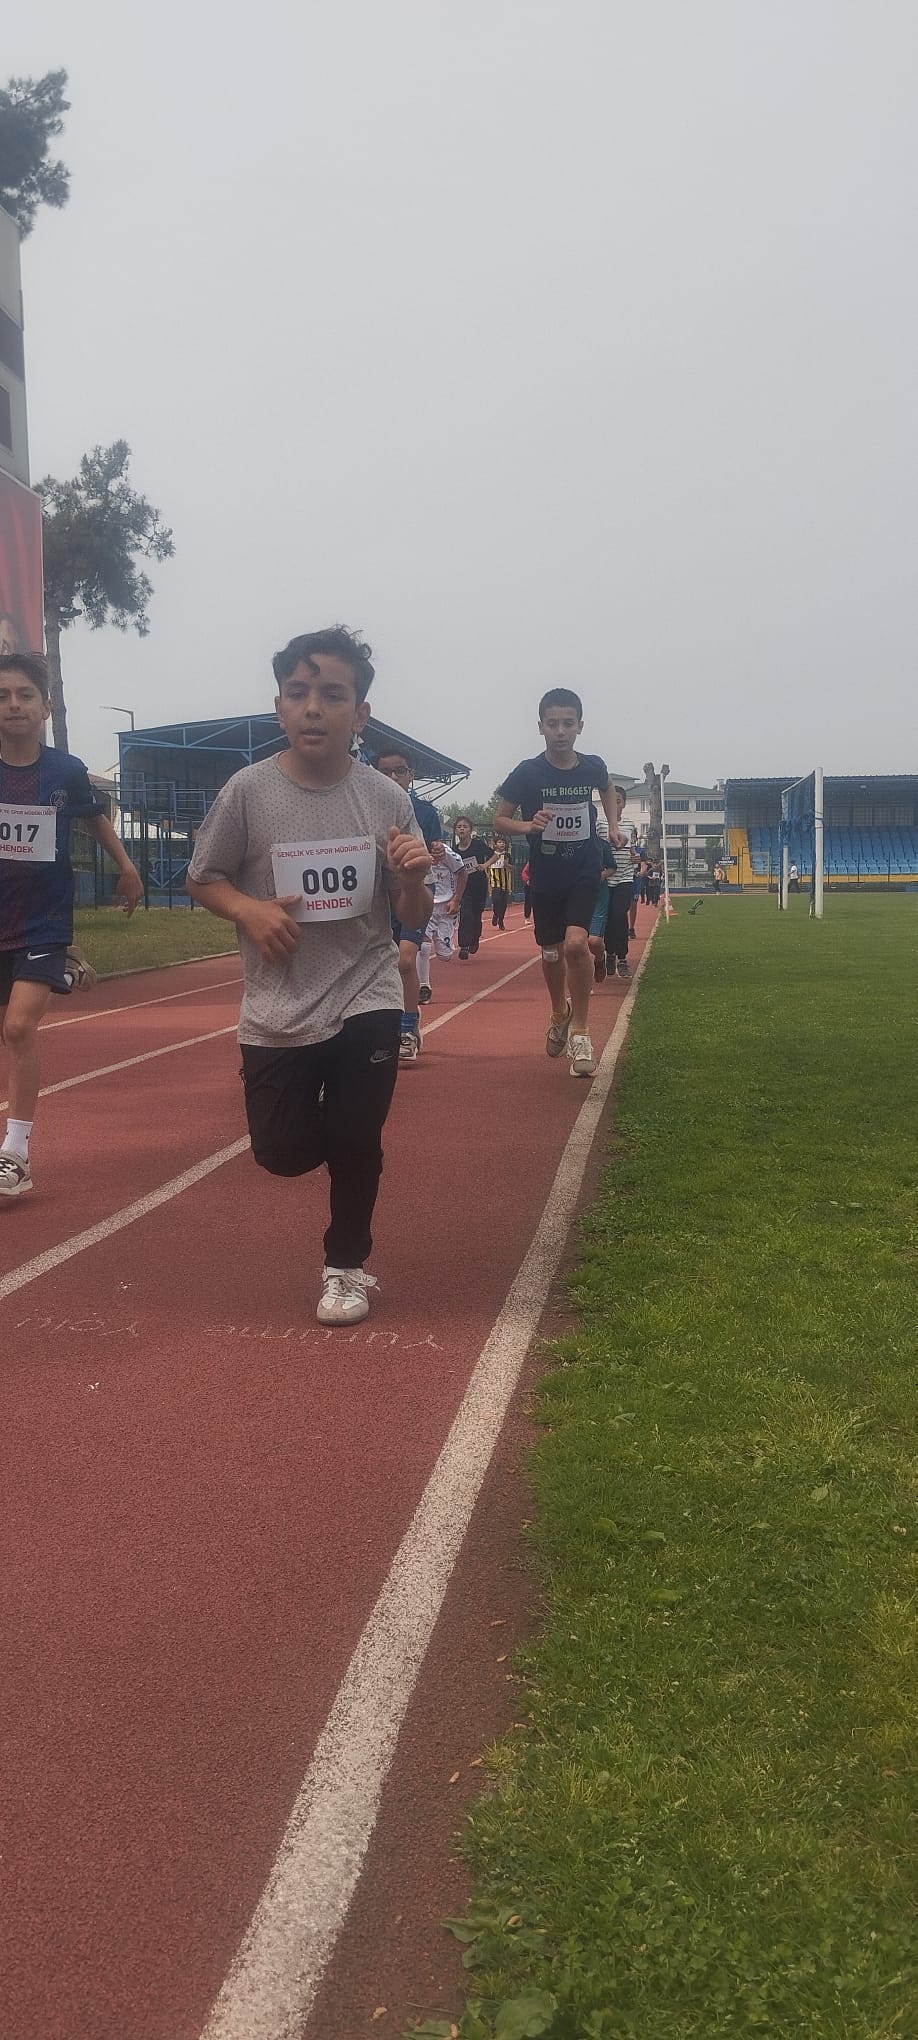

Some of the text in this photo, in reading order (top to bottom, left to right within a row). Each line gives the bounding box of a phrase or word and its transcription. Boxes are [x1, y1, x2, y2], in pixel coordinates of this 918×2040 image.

[541, 786, 592, 797] THE BIGGEST
[556, 816, 582, 829] 005
[0, 822, 39, 843] 017
[0, 844, 34, 853] HENDEK
[316, 847, 333, 855] SPOR
[302, 865, 358, 895] 008
[306, 897, 353, 911] HENDEK
